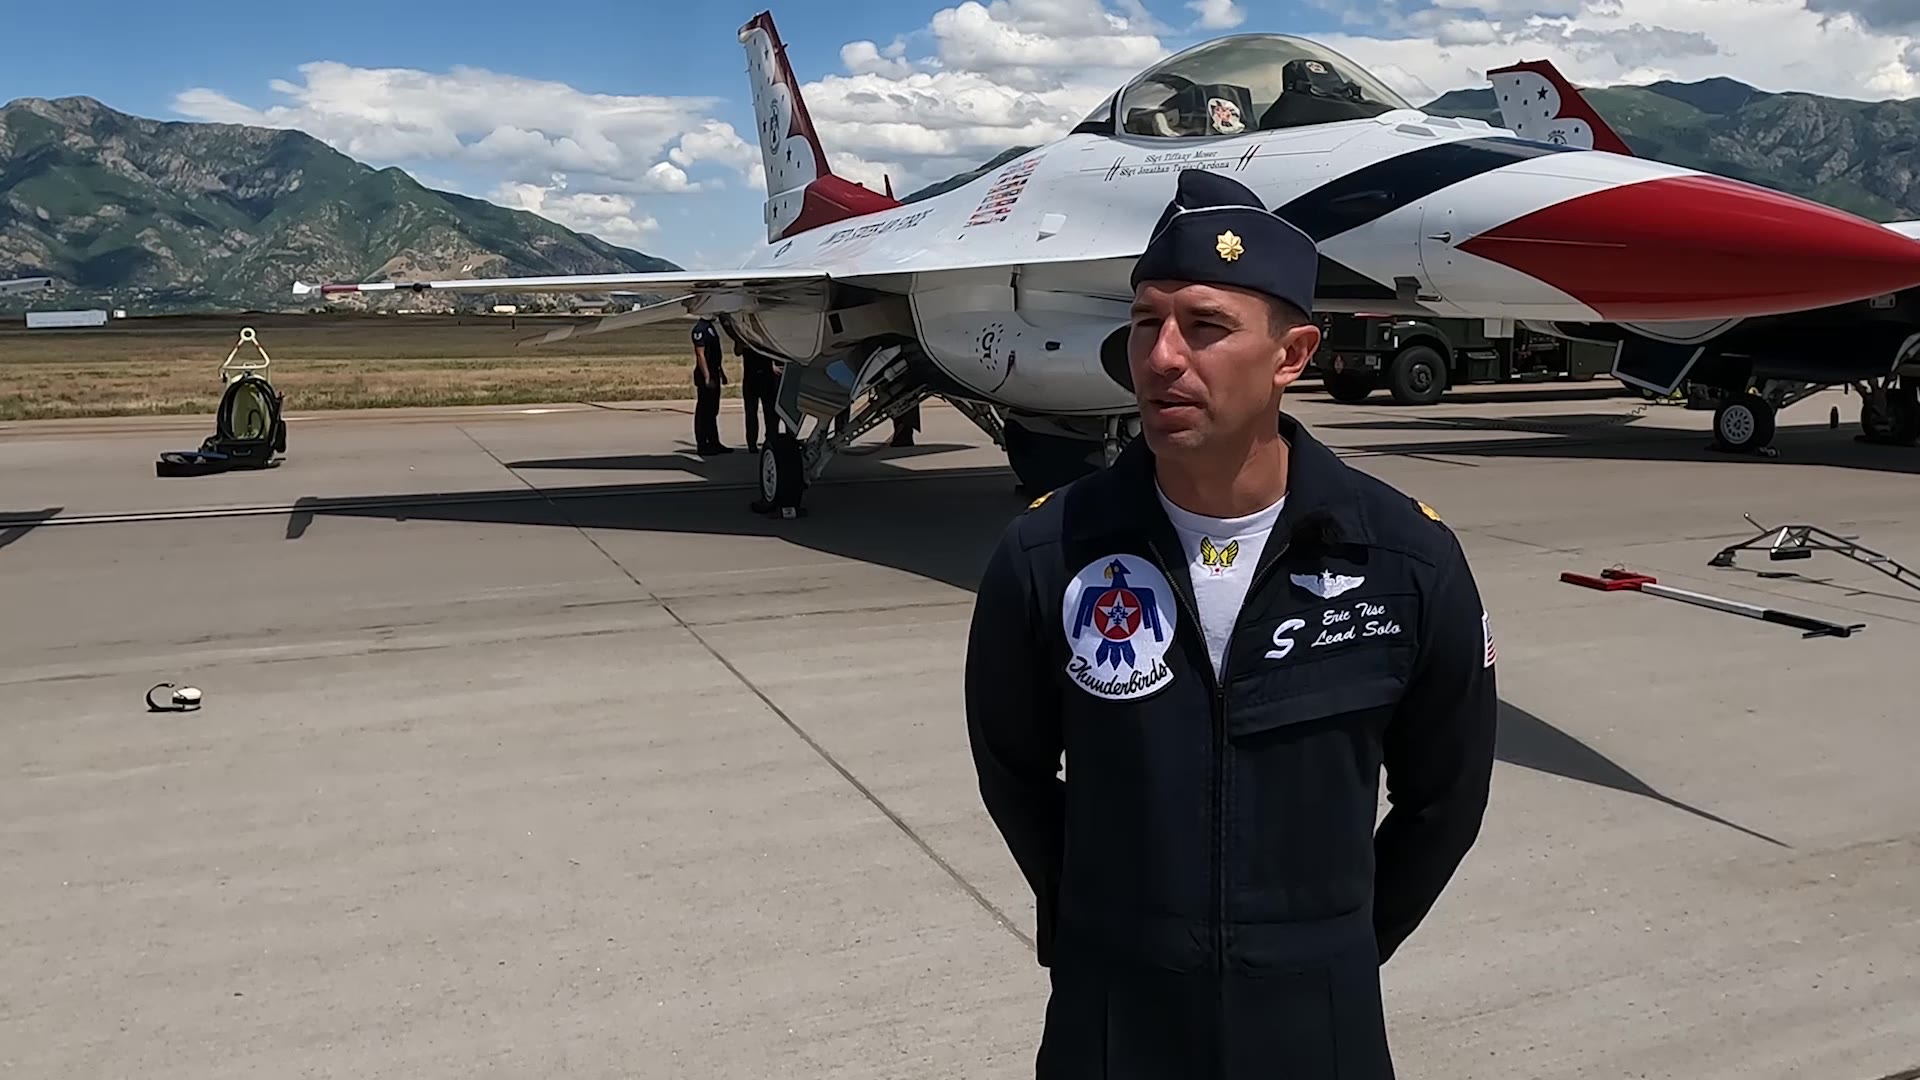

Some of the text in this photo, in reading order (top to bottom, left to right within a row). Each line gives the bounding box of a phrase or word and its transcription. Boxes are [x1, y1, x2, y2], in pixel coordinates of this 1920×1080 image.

[1322, 602, 1385, 626] Eric Tise
[1311, 620, 1401, 648] Lead Solo
[1069, 655, 1168, 696] Thunderbirds
